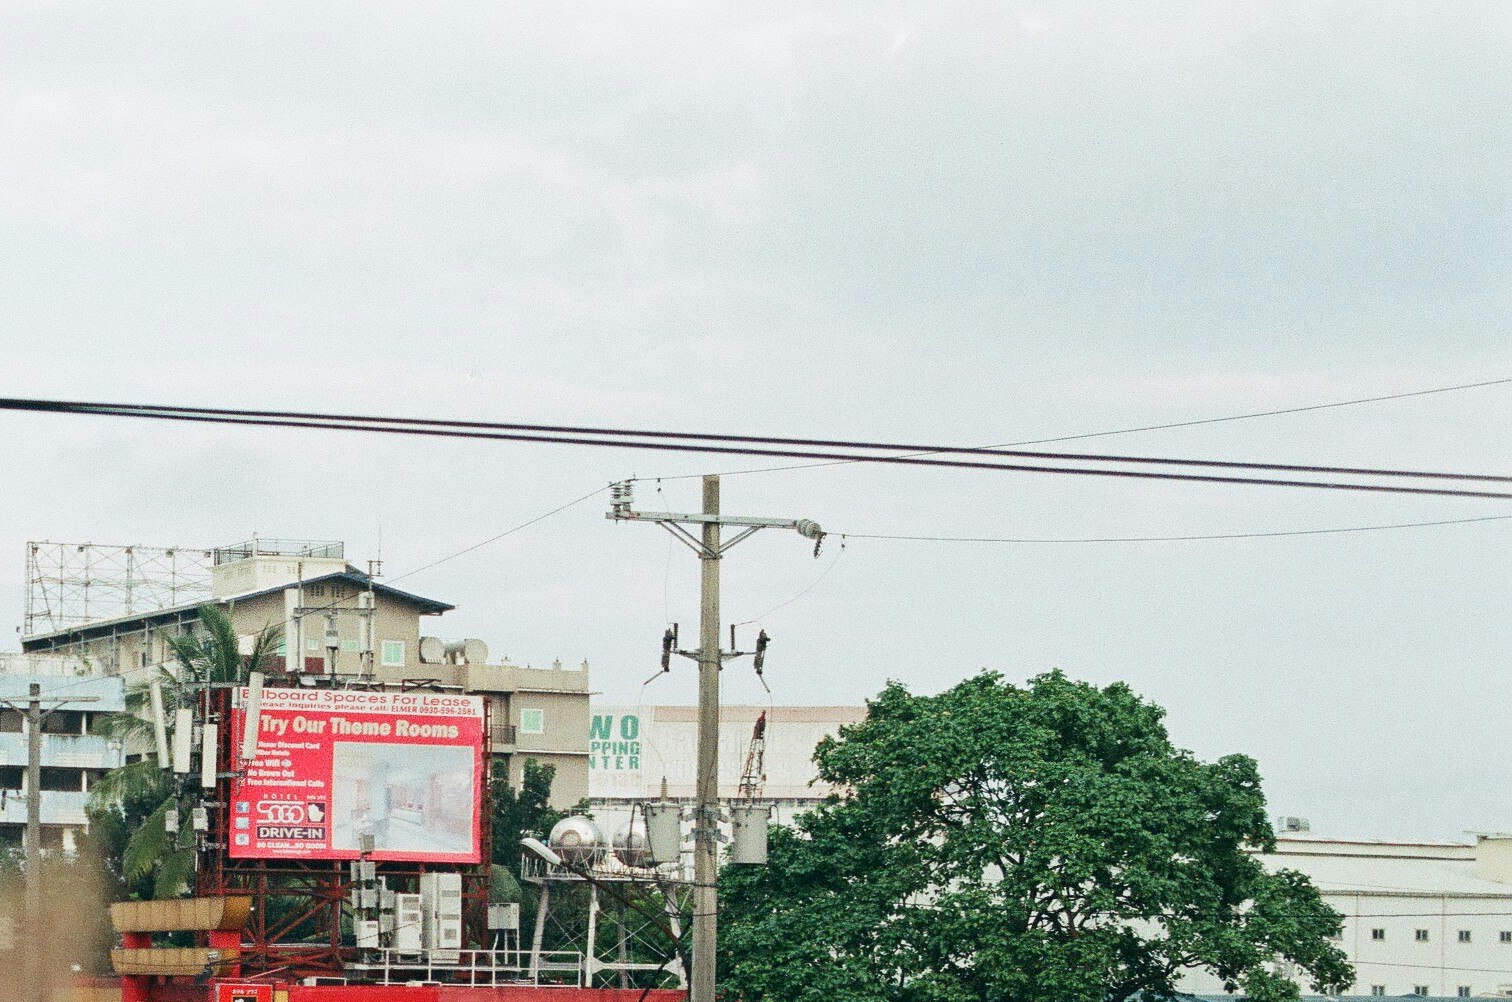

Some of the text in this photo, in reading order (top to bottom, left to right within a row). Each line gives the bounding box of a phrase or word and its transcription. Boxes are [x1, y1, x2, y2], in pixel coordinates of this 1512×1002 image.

[242, 689, 471, 707] Blboard Spaces For Lease
[261, 715, 459, 739] Try Our Theme Rooms
[259, 827, 323, 839] DRIVE-IN
